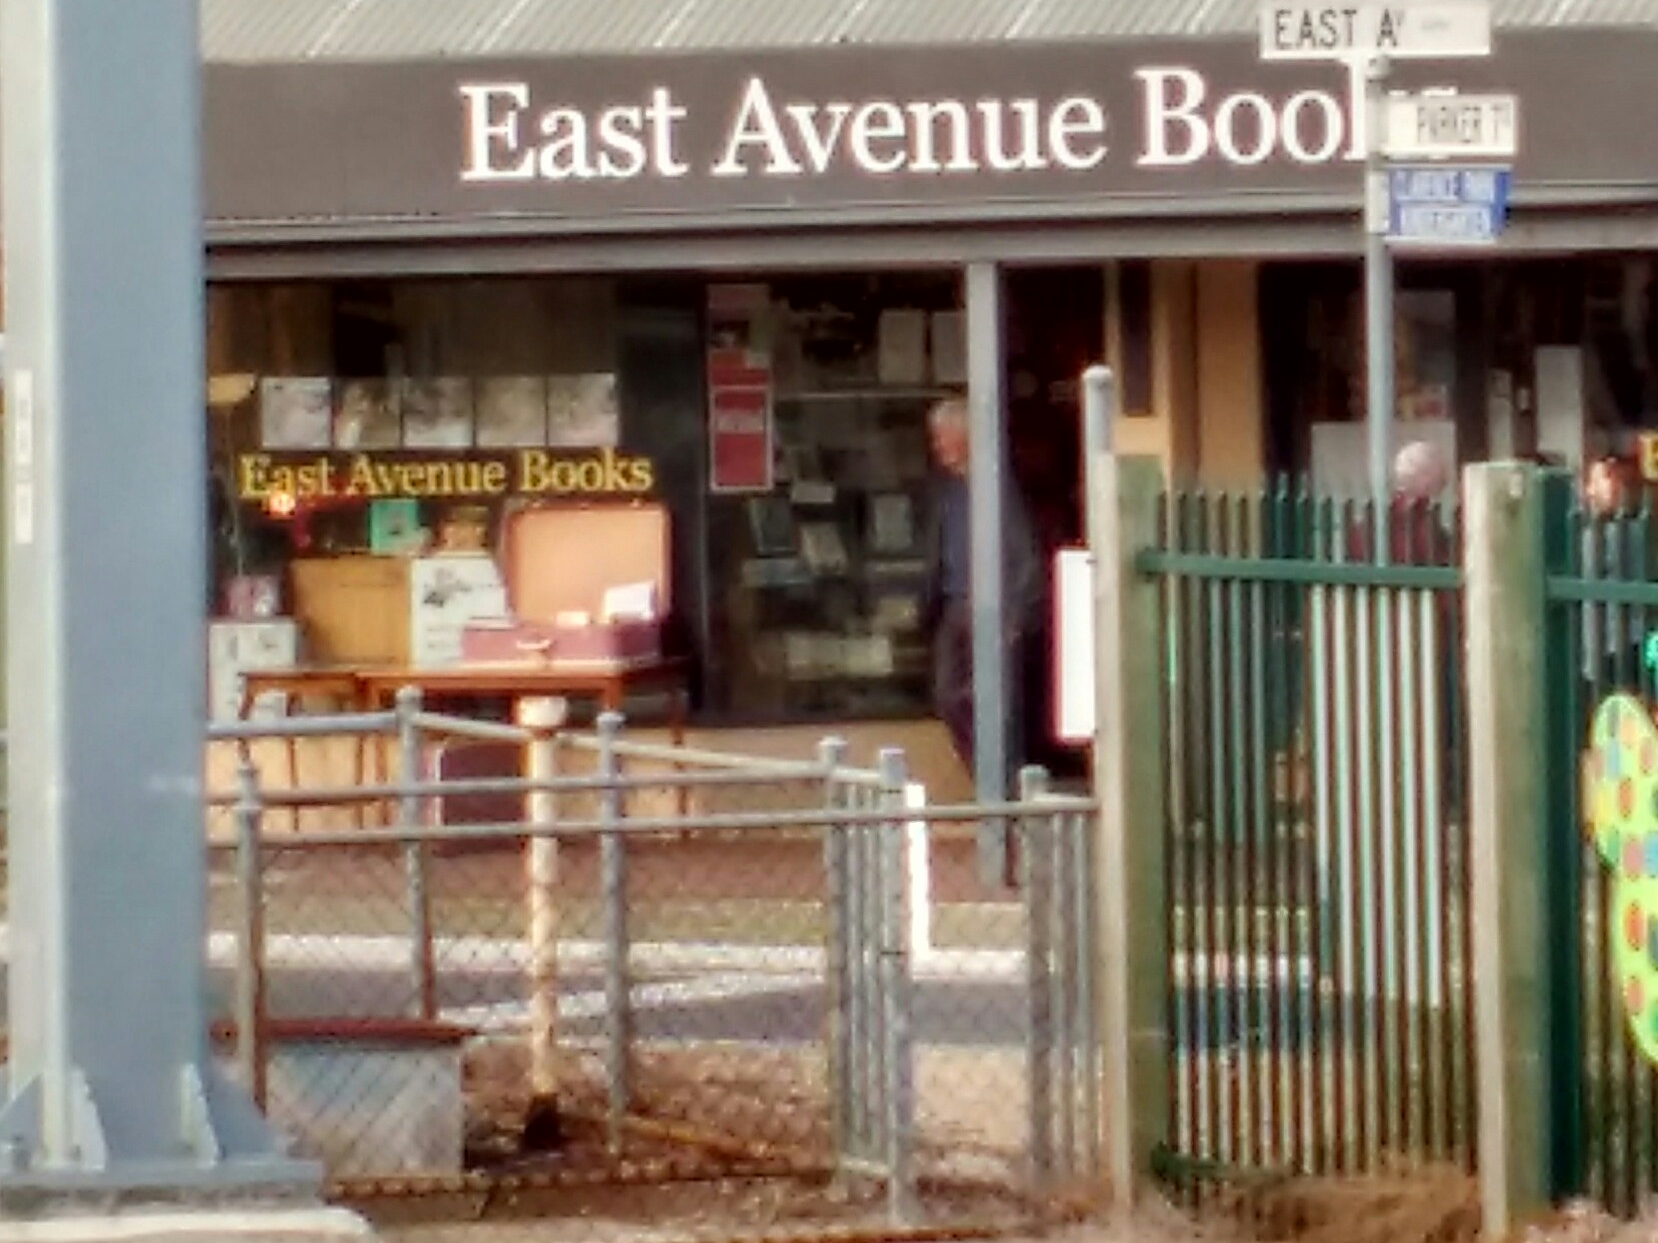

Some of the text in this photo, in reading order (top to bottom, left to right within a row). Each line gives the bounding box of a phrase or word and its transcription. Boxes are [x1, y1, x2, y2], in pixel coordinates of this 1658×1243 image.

[1273, 6, 1405, 50] EAST A
[459, 66, 1457, 184] East Avenue Boo
[239, 449, 653, 499] East Avenue Books
